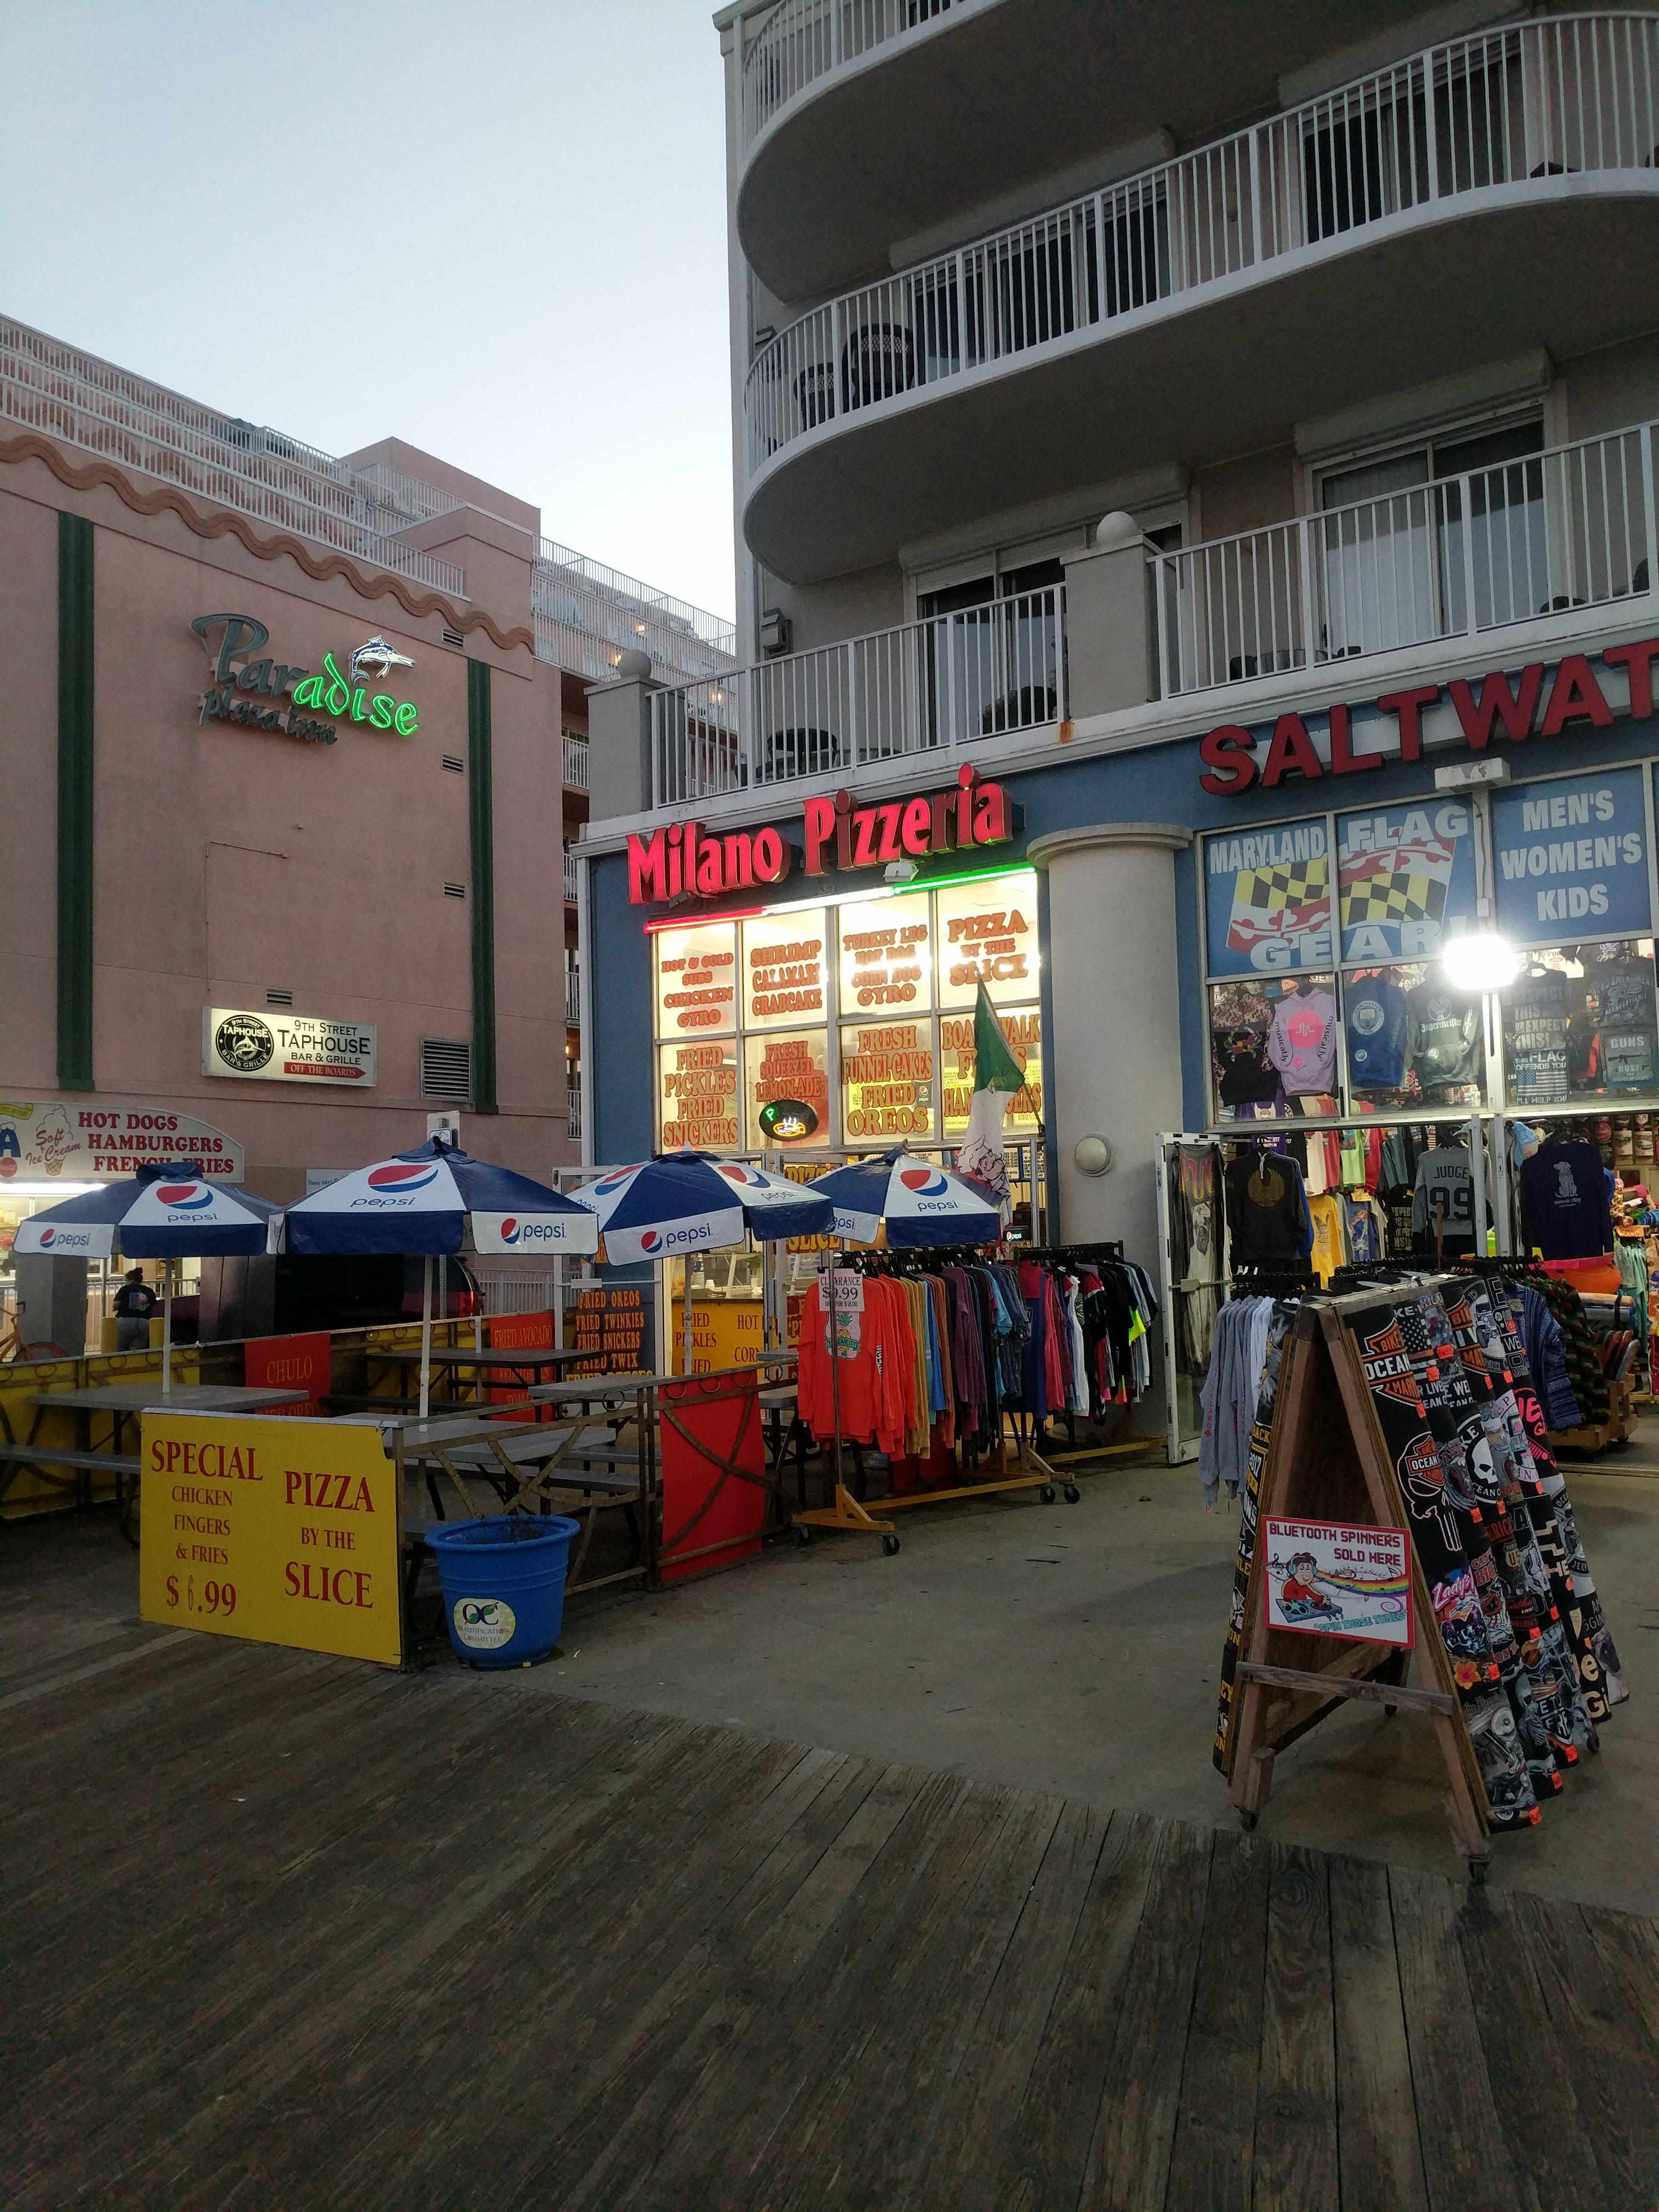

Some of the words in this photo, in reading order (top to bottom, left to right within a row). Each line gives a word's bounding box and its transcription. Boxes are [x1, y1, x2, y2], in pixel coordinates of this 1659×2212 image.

[191, 612, 420, 736] Paradise
[1522, 790, 1615, 833] MEN'S
[627, 821, 790, 904] Milano
[803, 763, 1013, 876] Pizzeria
[1346, 805, 1468, 854] FLAG
[1210, 826, 1328, 875] MARYLAND
[1501, 832, 1643, 881] WOMEN'S
[1537, 884, 1610, 922] KIDS
[948, 910, 1028, 943] PIZZA
[843, 929, 897, 951] TURKEY
[900, 925, 928, 944] LEG
[961, 943, 981, 957] BY
[984, 938, 1016, 955] THE
[661, 958, 686, 973] HOT
[701, 952, 733, 968] COLD
[750, 939, 822, 968] SHRIMP
[683, 971, 713, 986] SUBS
[950, 954, 1028, 986] SLICE
[664, 986, 733, 1009] CHICKEN
[752, 989, 822, 1016] CRABCAKE
[857, 983, 916, 1006] GYRO
[295, 1020, 315, 1032] 9TH
[320, 1022, 357, 1036] STREET
[677, 1009, 721, 1027] GYRO
[222, 1024, 269, 1038] TAPHOUSE
[278, 1029, 370, 1055] TAPHOUSE
[858, 1025, 917, 1053] FRESH
[765, 1040, 809, 1062] FRESH
[1610, 1036, 1645, 1049] GUNS
[221, 1050, 235, 1065] BAR
[243, 1052, 269, 1068] GRILLE
[291, 1052, 312, 1062] BAR
[315, 1052, 323, 1062] &
[326, 1055, 361, 1065] GRILLE
[676, 1046, 723, 1071] FRIED
[1529, 1050, 1567, 1062] FLAG
[1551, 1061, 1567, 1069] YOU
[290, 1064, 305, 1073] OFF
[308, 1066, 323, 1074] THE
[325, 1067, 356, 1076] BOARDS
[760, 1057, 814, 1080] SQUEEZED
[842, 1054, 891, 1085] FUNNEL
[891, 1050, 932, 1081] CAKES
[664, 1069, 736, 1098] PICKLES
[861, 1082, 916, 1109] FRIED
[1531, 1096, 1551, 1104] HELP
[677, 1096, 725, 1120] FRIED
[78, 1111, 120, 1128] HOT
[127, 1114, 178, 1131] DOGS
[663, 1117, 738, 1147] SNICKERS
[848, 1106, 928, 1136] OREOS
[36, 1127, 64, 1146] Soft
[87, 1133, 223, 1152] HAMBURGERS
[26, 1152, 43, 1166] Ice
[44, 1142, 81, 1162] Cream
[1434, 1165, 1469, 1180] JUDGE
[350, 1196, 415, 1207] pepsi
[761, 1190, 794, 1202] pepsi
[918, 1201, 958, 1212] pepsi
[1428, 1186, 1474, 1219] 99
[168, 1213, 217, 1222] pepsi
[833, 1216, 856, 1230] epsi
[57, 1233, 91, 1248] pepsi
[523, 1222, 566, 1242] pepsi
[667, 1223, 711, 1248] pepsi
[579, 1292, 607, 1310] FRIED
[611, 1290, 641, 1307] OREOS
[575, 1314, 601, 1331] FRIED
[604, 1311, 644, 1330] TWINKIES
[737, 1314, 759, 1331] HOT
[494, 1328, 517, 1349] FRIED
[517, 1325, 552, 1348] AVOCADO
[577, 1332, 600, 1351] FRIED
[603, 1331, 640, 1350] SNICKERS
[675, 1332, 717, 1348] PIKLES
[611, 1352, 638, 1368] TWIX
[151, 1439, 263, 1481] SPECIAL
[1411, 1455, 1438, 1470] OCEAN
[172, 1485, 233, 1507] CHICKEN
[284, 1470, 375, 1513] PIZZA
[173, 1514, 231, 1536] FINGERS
[1269, 1522, 1338, 1542] BLUETOOTH
[1340, 1530, 1401, 1548] SPINNERS
[301, 1527, 318, 1546] BY
[323, 1529, 356, 1551] THE
[175, 1542, 187, 1560] &
[191, 1544, 228, 1565] FRIES
[1334, 1548, 1366, 1563] SOLD
[1369, 1551, 1402, 1567] HERE
[285, 1561, 373, 1609] SLICE
